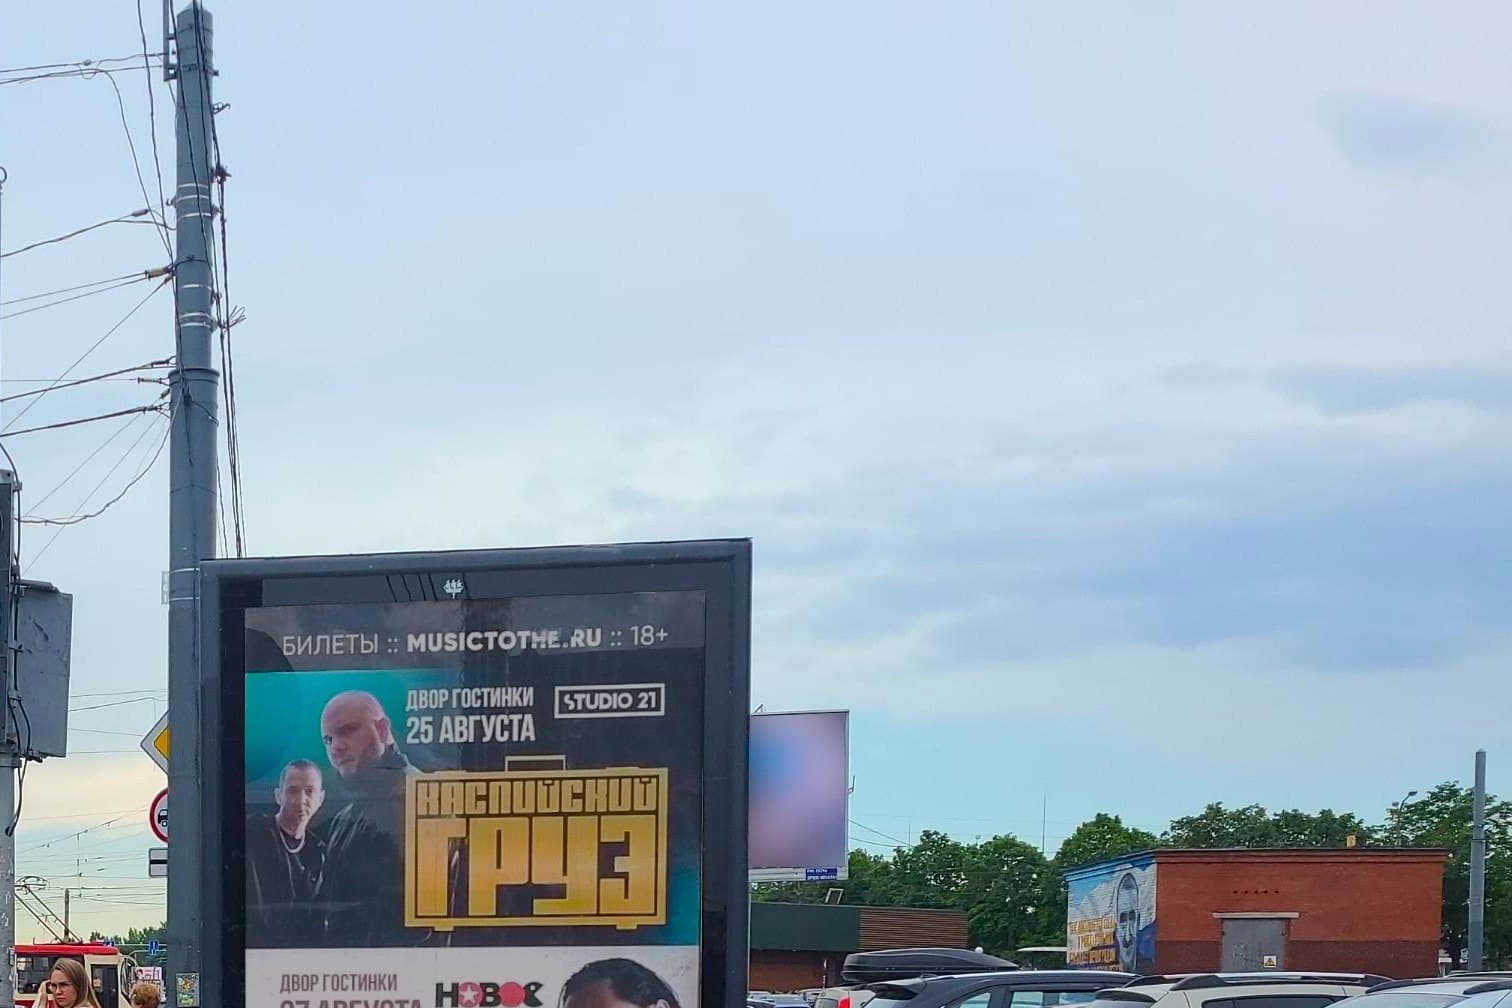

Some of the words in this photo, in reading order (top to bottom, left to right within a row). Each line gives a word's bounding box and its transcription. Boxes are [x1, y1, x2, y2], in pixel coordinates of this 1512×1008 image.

[283, 633, 379, 657] БИЛЕТЫ
[407, 627, 603, 654] MUSICTOTHE.RU
[631, 625, 669, 647] 18+
[405, 688, 449, 712] ДВОР
[451, 686, 534, 709] ГОСТИНКИ
[563, 692, 633, 712] STUDIO
[637, 691, 657, 709] 21
[406, 716, 433, 744] 25
[439, 713, 536, 743] АВГУСТА
[415, 776, 658, 815] КАСПИЙСКИЙ
[414, 814, 657, 917] ГРУЗ
[280, 974, 319, 994] ДВОР
[322, 972, 398, 993] ГОСТИНКИ
